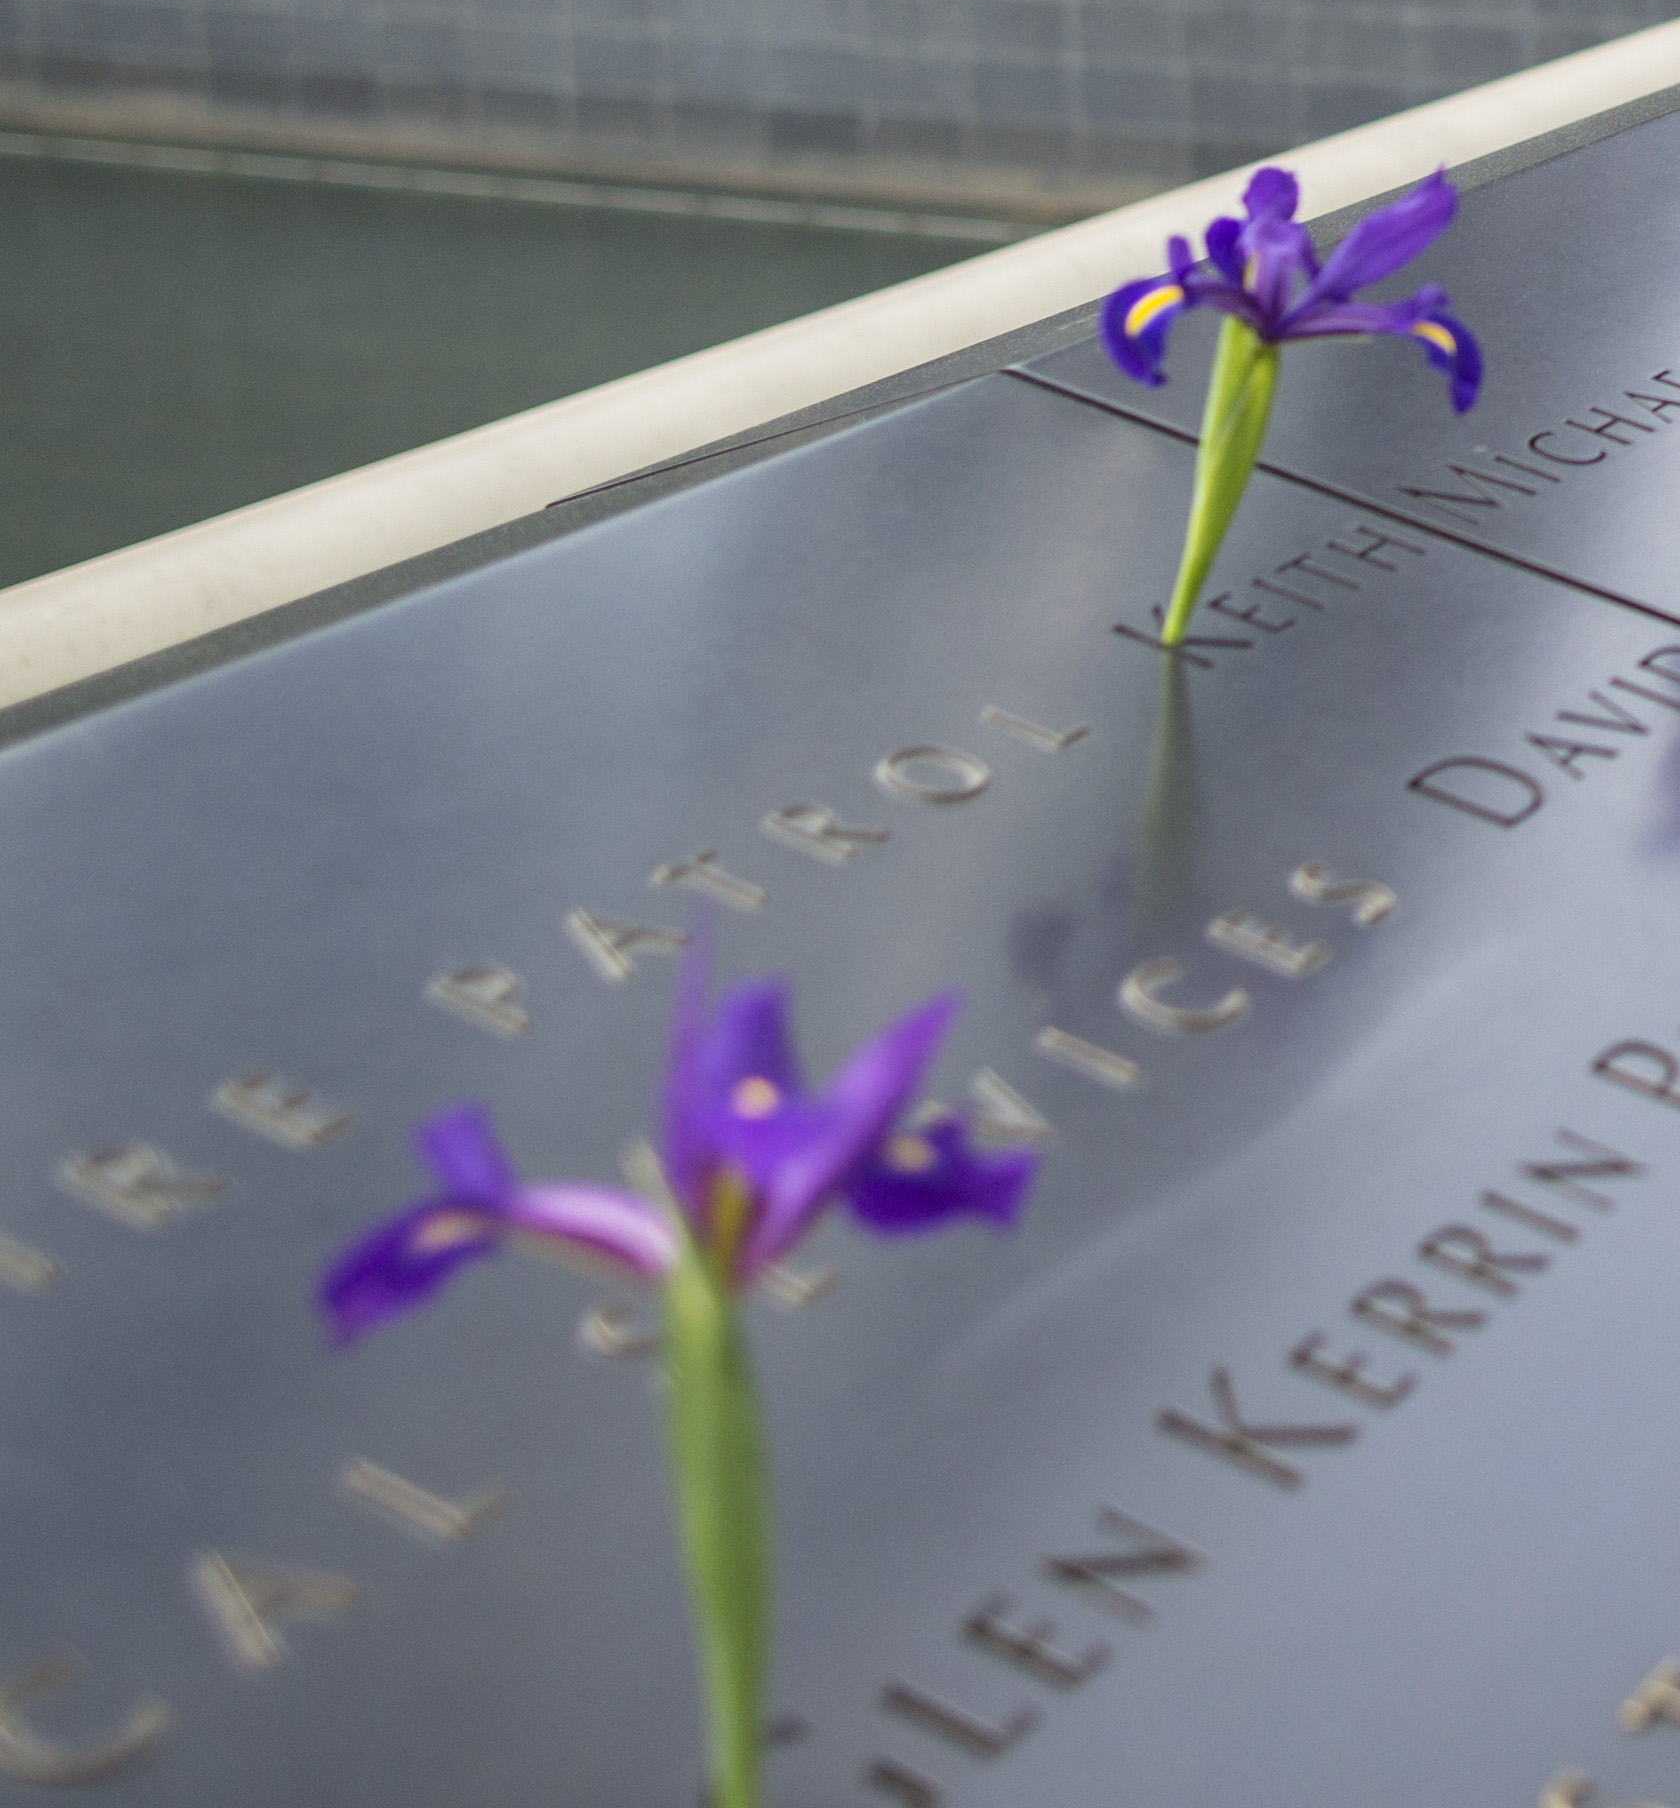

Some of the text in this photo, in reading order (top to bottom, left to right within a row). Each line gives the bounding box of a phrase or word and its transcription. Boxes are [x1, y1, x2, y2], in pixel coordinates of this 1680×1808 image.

[1112, 523, 1427, 670] KEITH
[426, 702, 1093, 1035] PATROL
[1154, 1128, 1652, 1493] KERRIN
